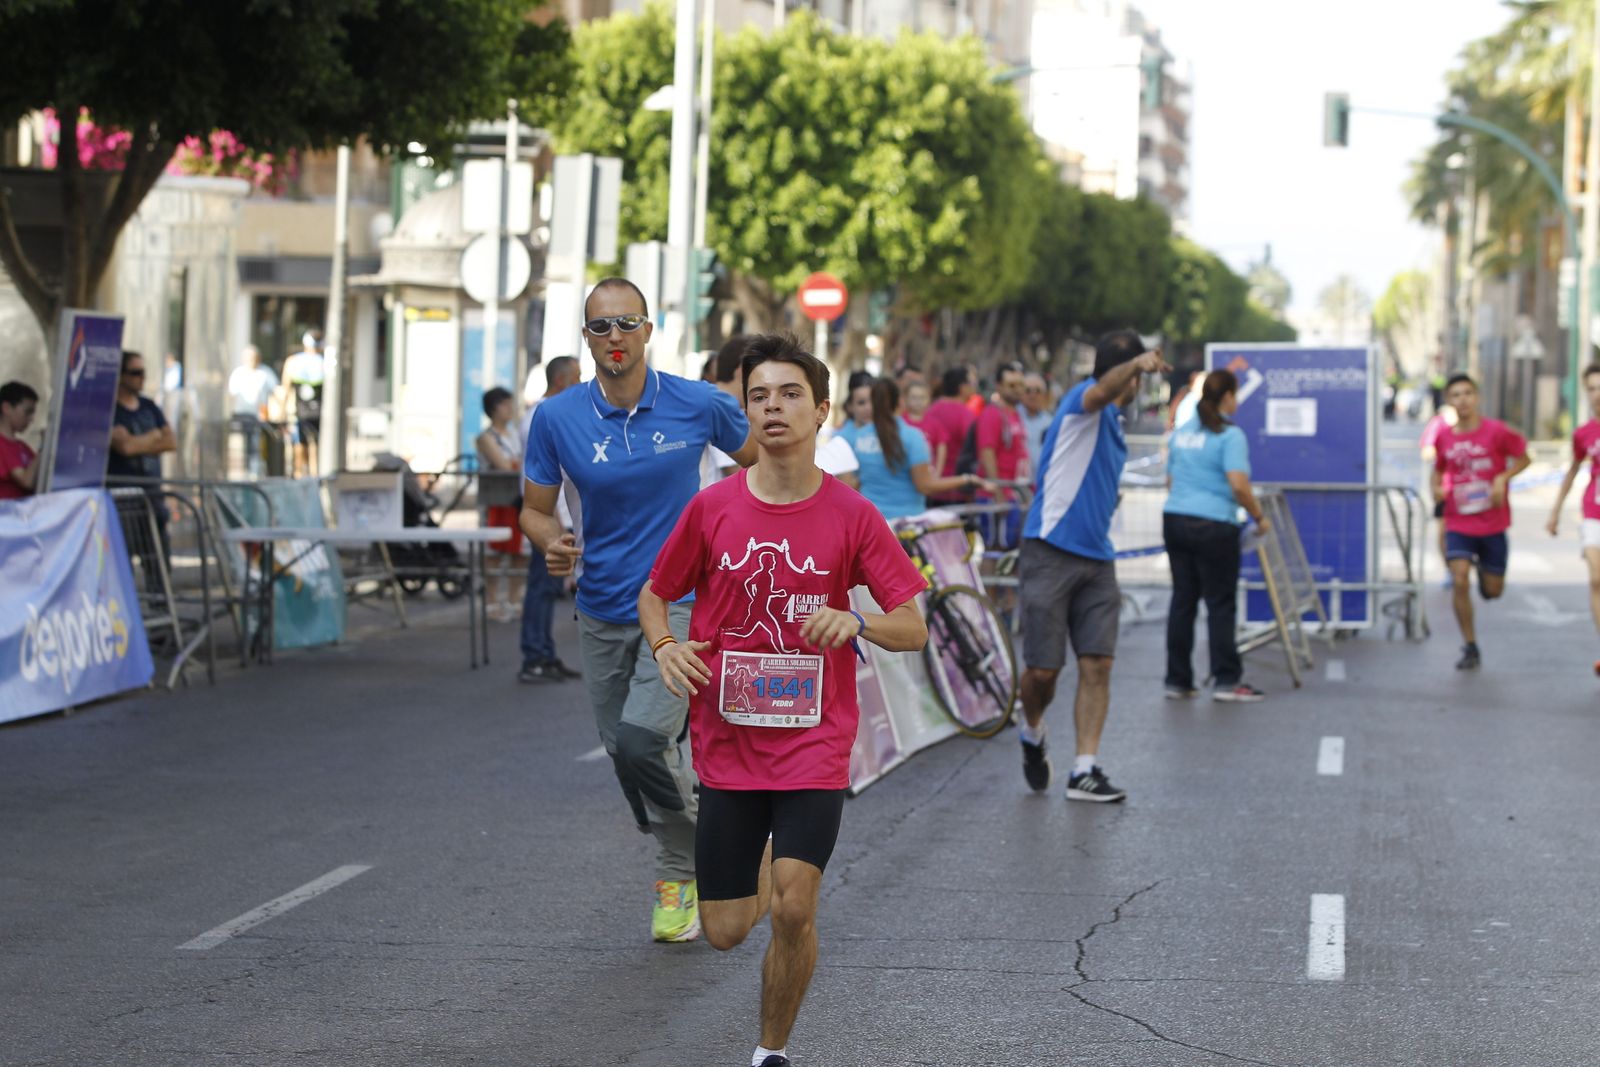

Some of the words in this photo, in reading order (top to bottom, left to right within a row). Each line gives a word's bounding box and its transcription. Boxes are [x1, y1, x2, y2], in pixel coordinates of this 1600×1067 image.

[781, 594, 796, 623] 4
[20, 591, 128, 695] deportes
[763, 658, 790, 666] CARRERA
[790, 659, 818, 667] SOLIDARIA
[752, 676, 814, 699] 1541
